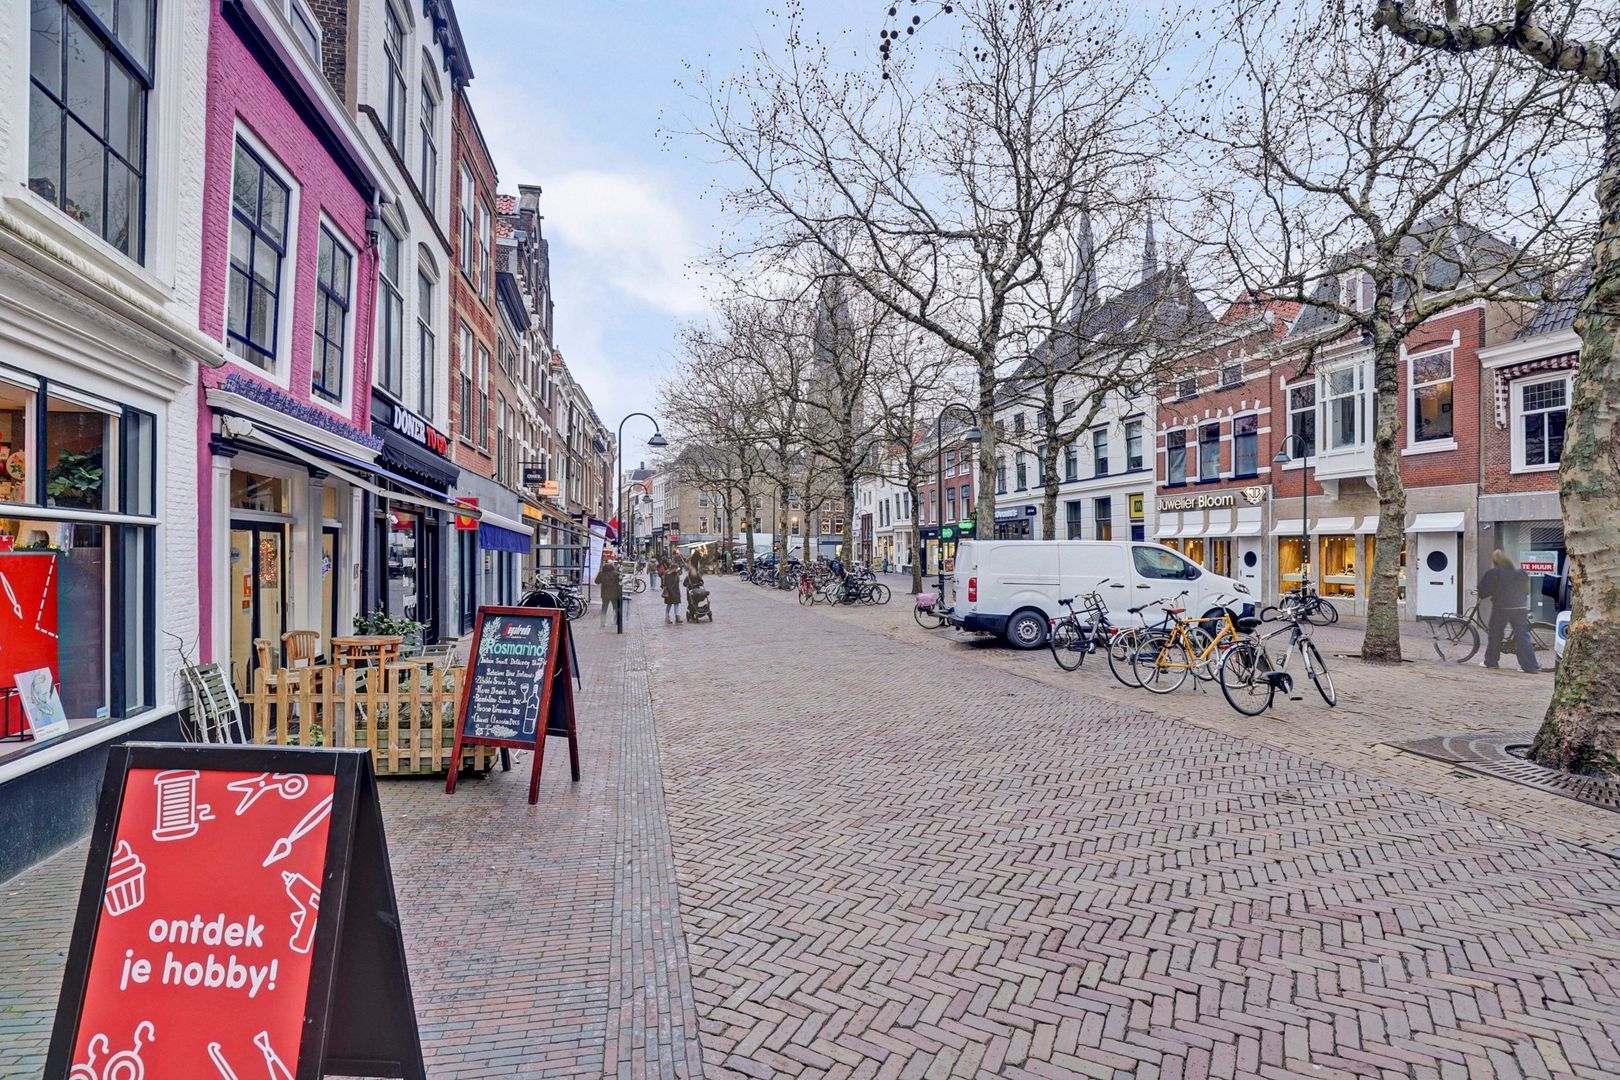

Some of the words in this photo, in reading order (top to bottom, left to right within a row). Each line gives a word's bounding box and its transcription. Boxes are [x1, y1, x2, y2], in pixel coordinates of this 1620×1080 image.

[1158, 497, 1196, 511] Juwelier
[1198, 494, 1234, 508] Bloom
[486, 638, 544, 656] Rosmarino
[148, 912, 265, 948] ontdek
[119, 948, 152, 991] je
[162, 951, 279, 998] hobby!
